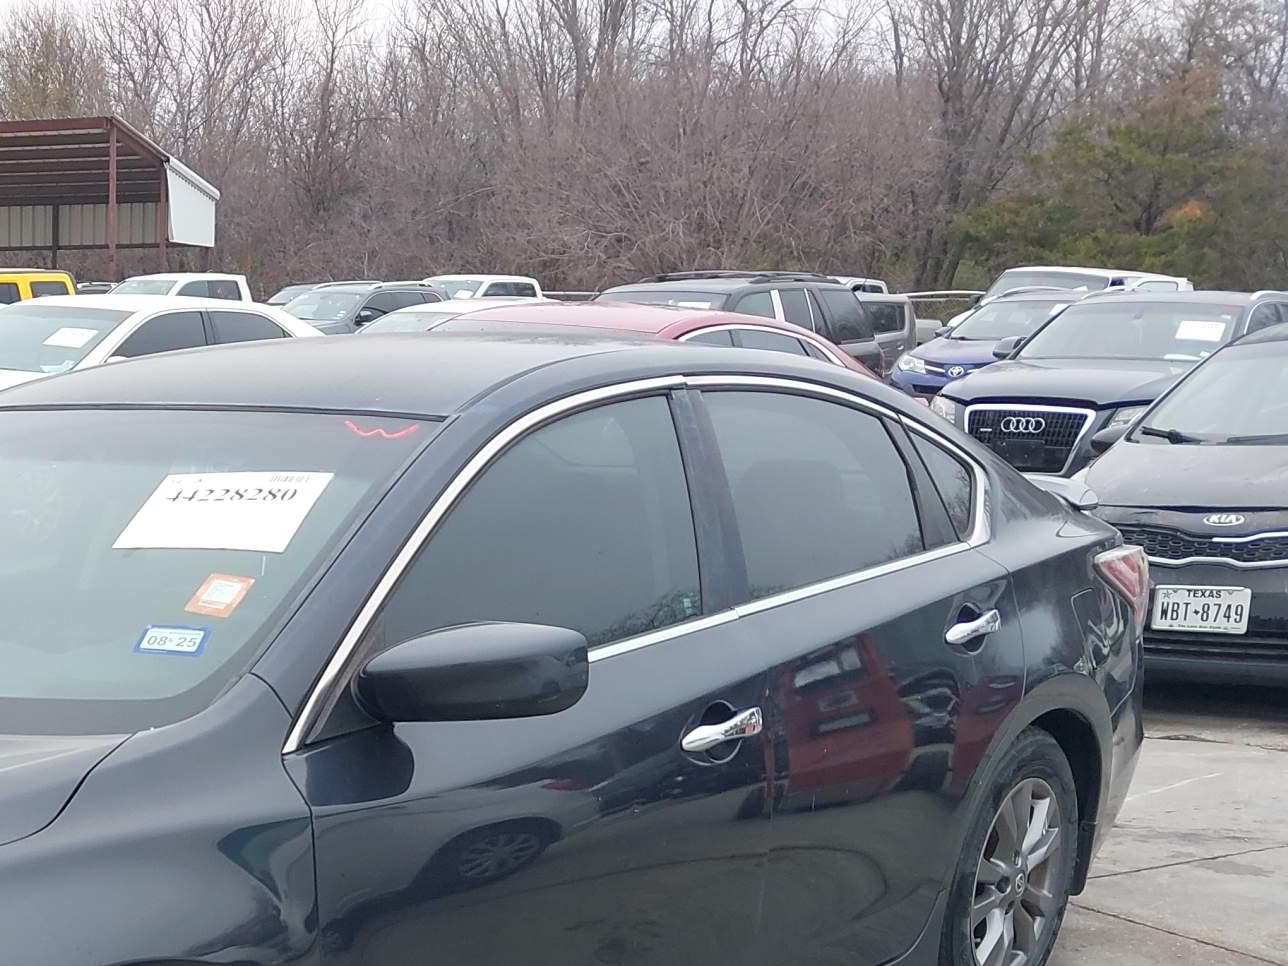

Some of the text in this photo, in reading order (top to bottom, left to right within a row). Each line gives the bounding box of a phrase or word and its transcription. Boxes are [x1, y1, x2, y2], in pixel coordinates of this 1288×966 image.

[166, 488, 298, 502] 44228280
[1208, 513, 1238, 523] KIA
[1187, 589, 1222, 598] TEXAS
